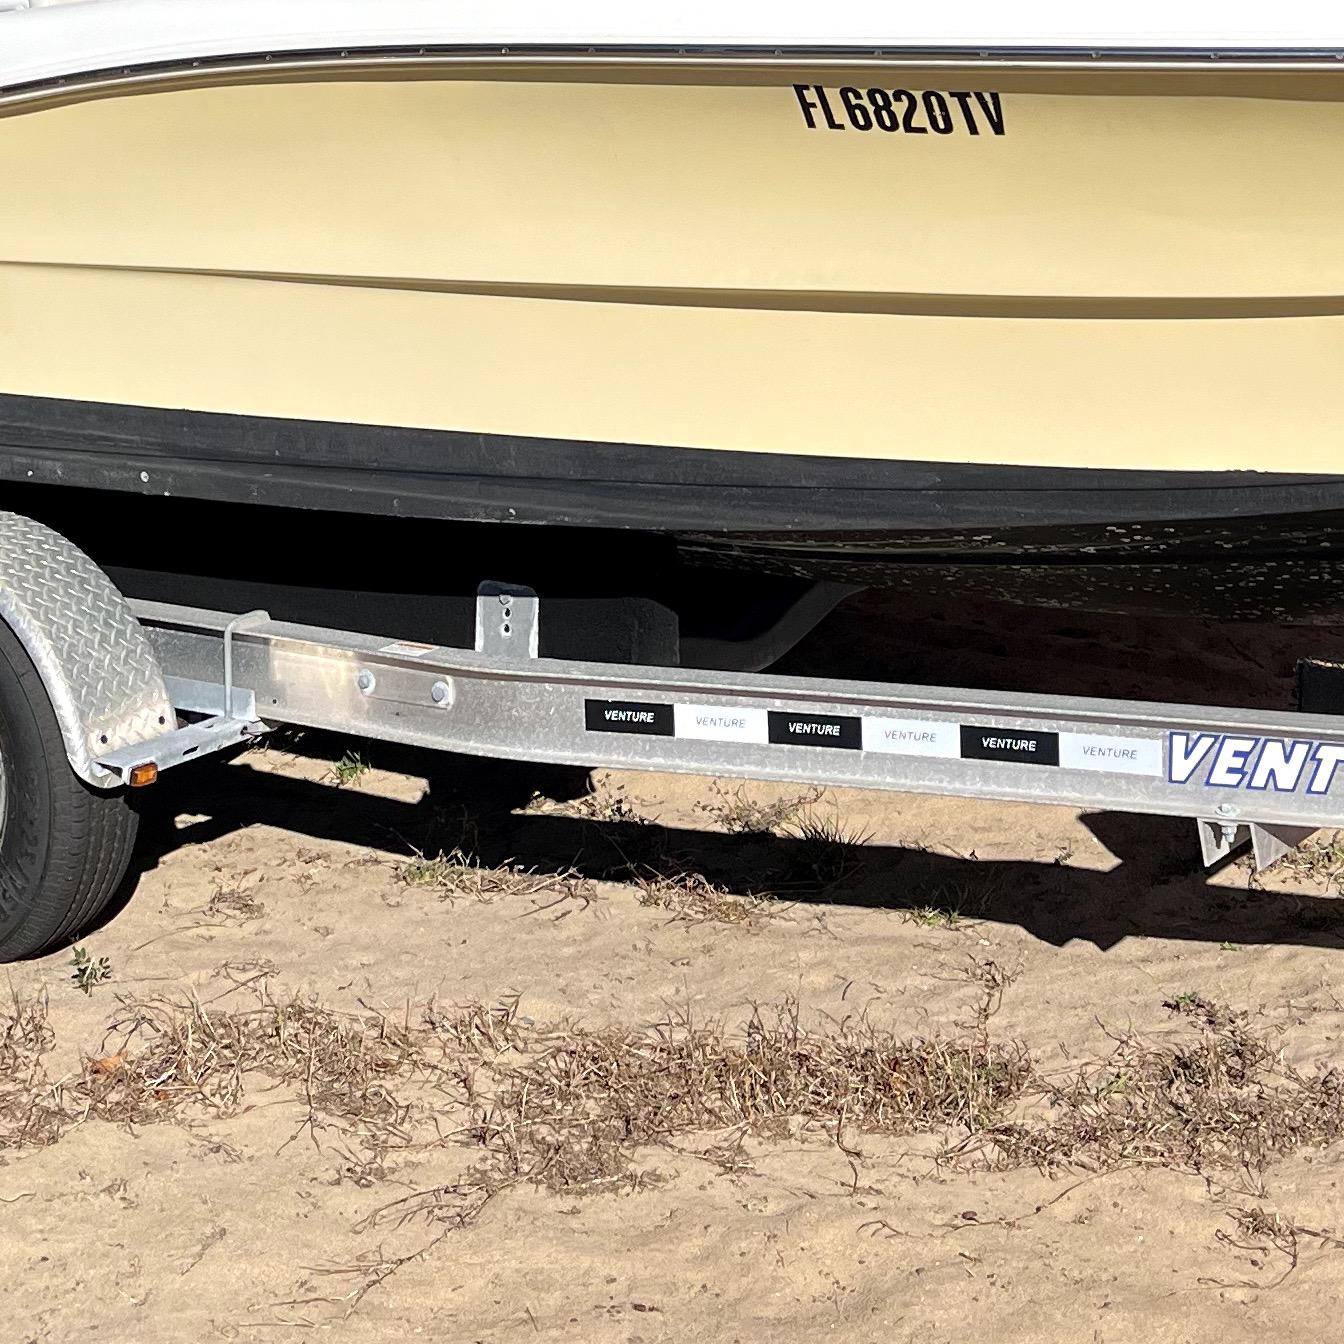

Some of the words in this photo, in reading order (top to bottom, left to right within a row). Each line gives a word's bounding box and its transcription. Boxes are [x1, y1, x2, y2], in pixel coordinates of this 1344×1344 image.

[792, 83, 1006, 136] FL6820TV
[604, 709, 655, 723] VENTURE
[695, 715, 746, 729] VENTURE
[788, 722, 841, 737] VENTURE
[884, 729, 937, 743] VENTURE
[982, 736, 1037, 752] VENTURE
[1082, 745, 1138, 760] VENTURE
